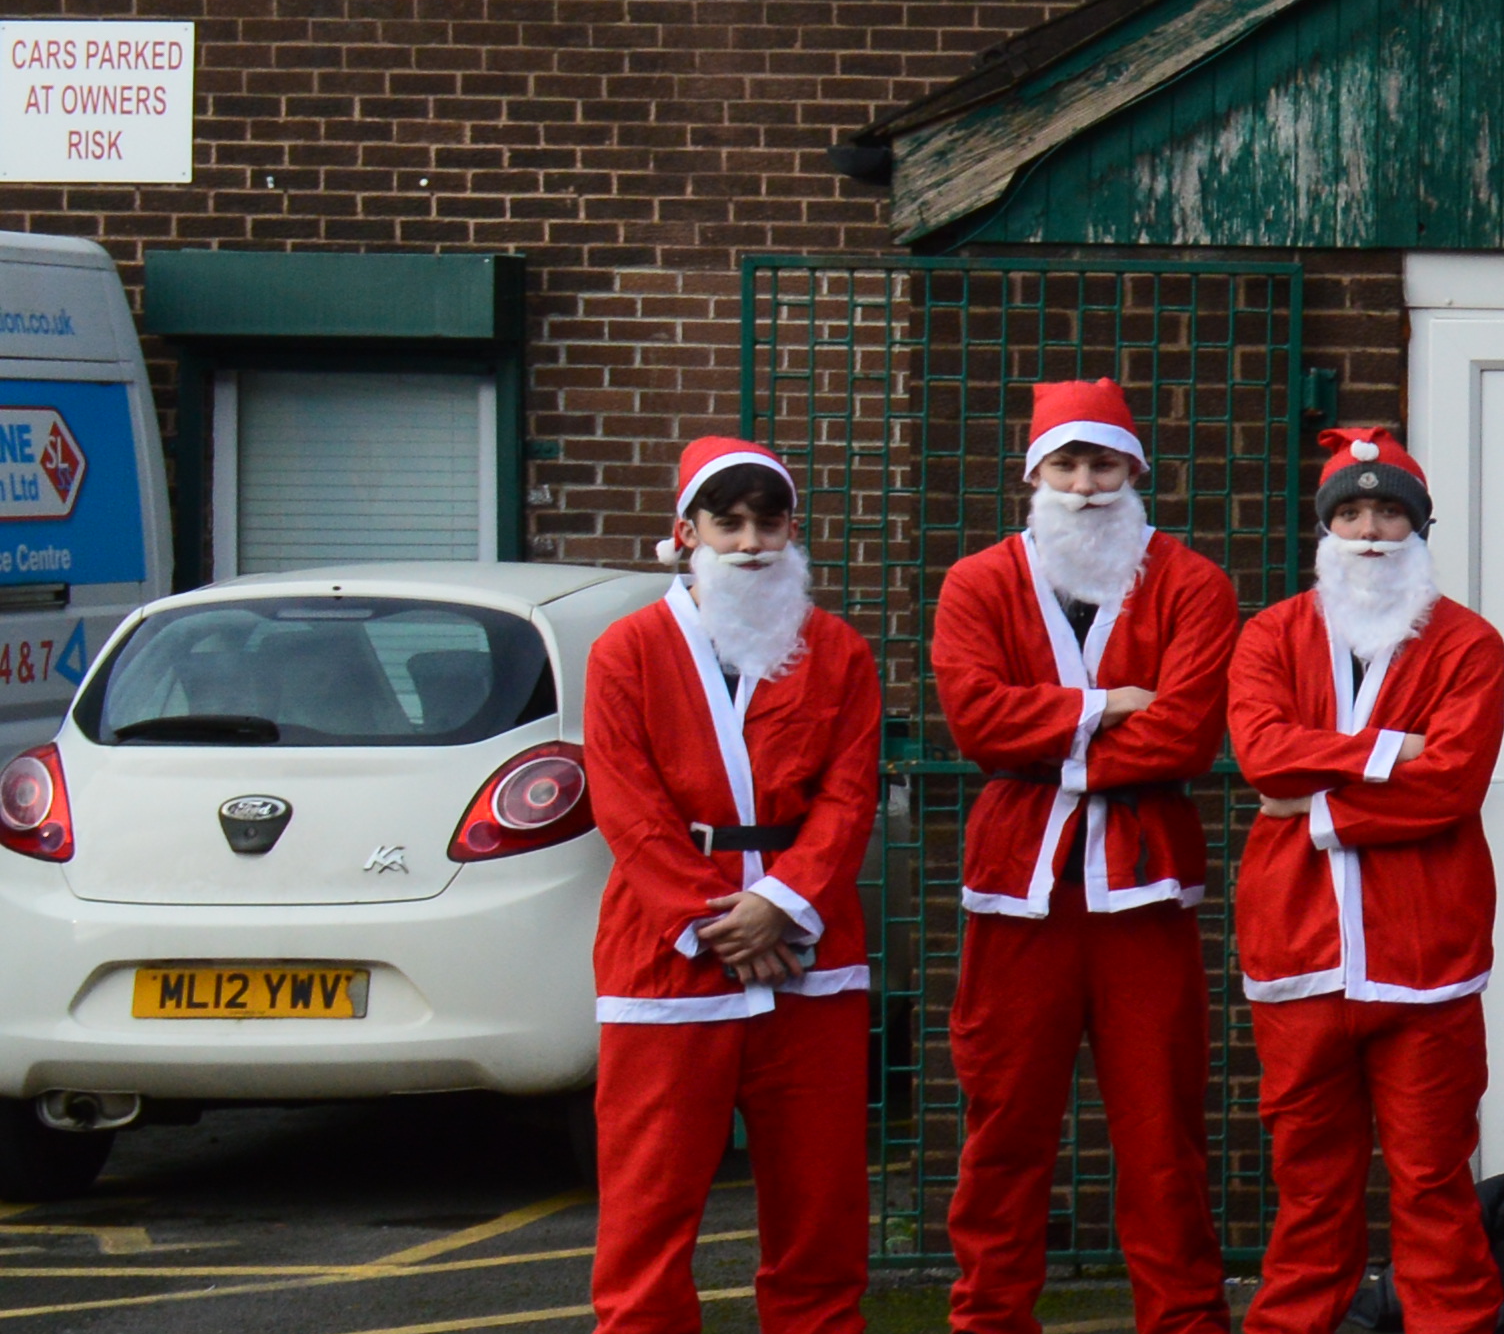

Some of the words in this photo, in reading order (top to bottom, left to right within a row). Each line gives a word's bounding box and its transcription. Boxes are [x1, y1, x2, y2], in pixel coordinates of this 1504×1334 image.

[12, 39, 77, 70] CARS
[85, 40, 183, 71] PARKED
[24, 84, 55, 115] AT
[61, 85, 167, 116] OWNERS
[67, 130, 123, 161] RISK
[9, 472, 40, 502] Ltd
[17, 544, 72, 572] Centre
[159, 971, 250, 1009] ML12
[263, 973, 343, 1009] YWV
